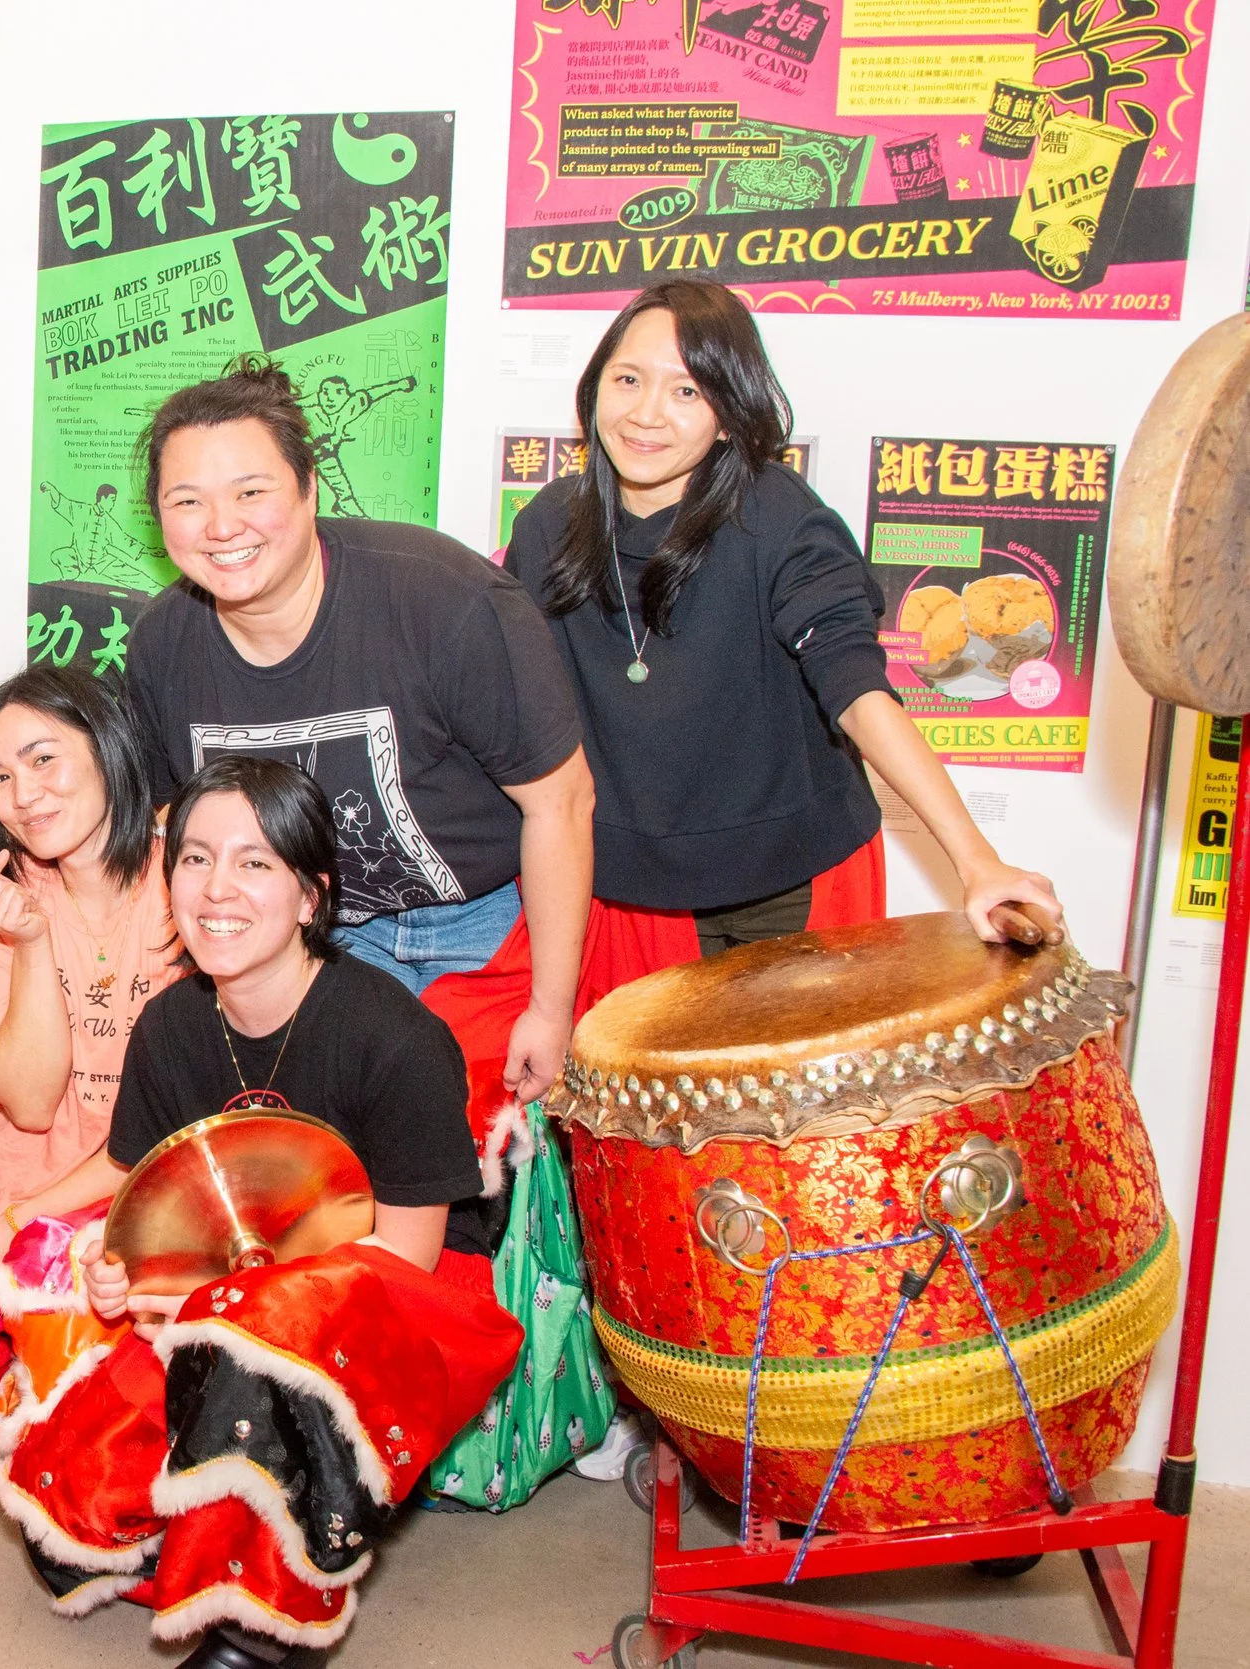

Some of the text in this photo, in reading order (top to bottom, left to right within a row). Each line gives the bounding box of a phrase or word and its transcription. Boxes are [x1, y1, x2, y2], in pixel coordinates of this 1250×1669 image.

[565, 107, 734, 119] When asked what her favorite
[562, 142, 776, 157] Jasmine pointed to the sprawling wall
[41, 114, 302, 250] 百利寶
[1027, 163, 1110, 213] Lime
[625, 190, 692, 226] 2009
[526, 217, 992, 280] SUN VIN GROCERY
[262, 195, 450, 326] 武術
[41, 251, 222, 326] MARTIAL ARTS SUPPLIES
[44, 269, 229, 354] BOK LEI PO
[871, 290, 1172, 312] 75 Mulberry, New York, NY 10013
[45, 297, 235, 380] TRADING INC
[171, 349, 236, 358] remaining martial
[876, 441, 1109, 503] 紙包蛋糕
[877, 527, 969, 539] MADE W/ FRESH
[876, 539, 961, 551] FRUITS, HERBS
[874, 551, 974, 563] & VEGGIES IN NYC
[1007, 540, 1063, 588] (646) 666-0036
[202, 713, 369, 744] FREE
[1206, 772, 1232, 781] Kaffir
[1204, 784, 1228, 793] fresh
[1202, 797, 1227, 806] curry
[83, 1017, 117, 1038] Wo
[83, 1092, 109, 1102] N. Y.
